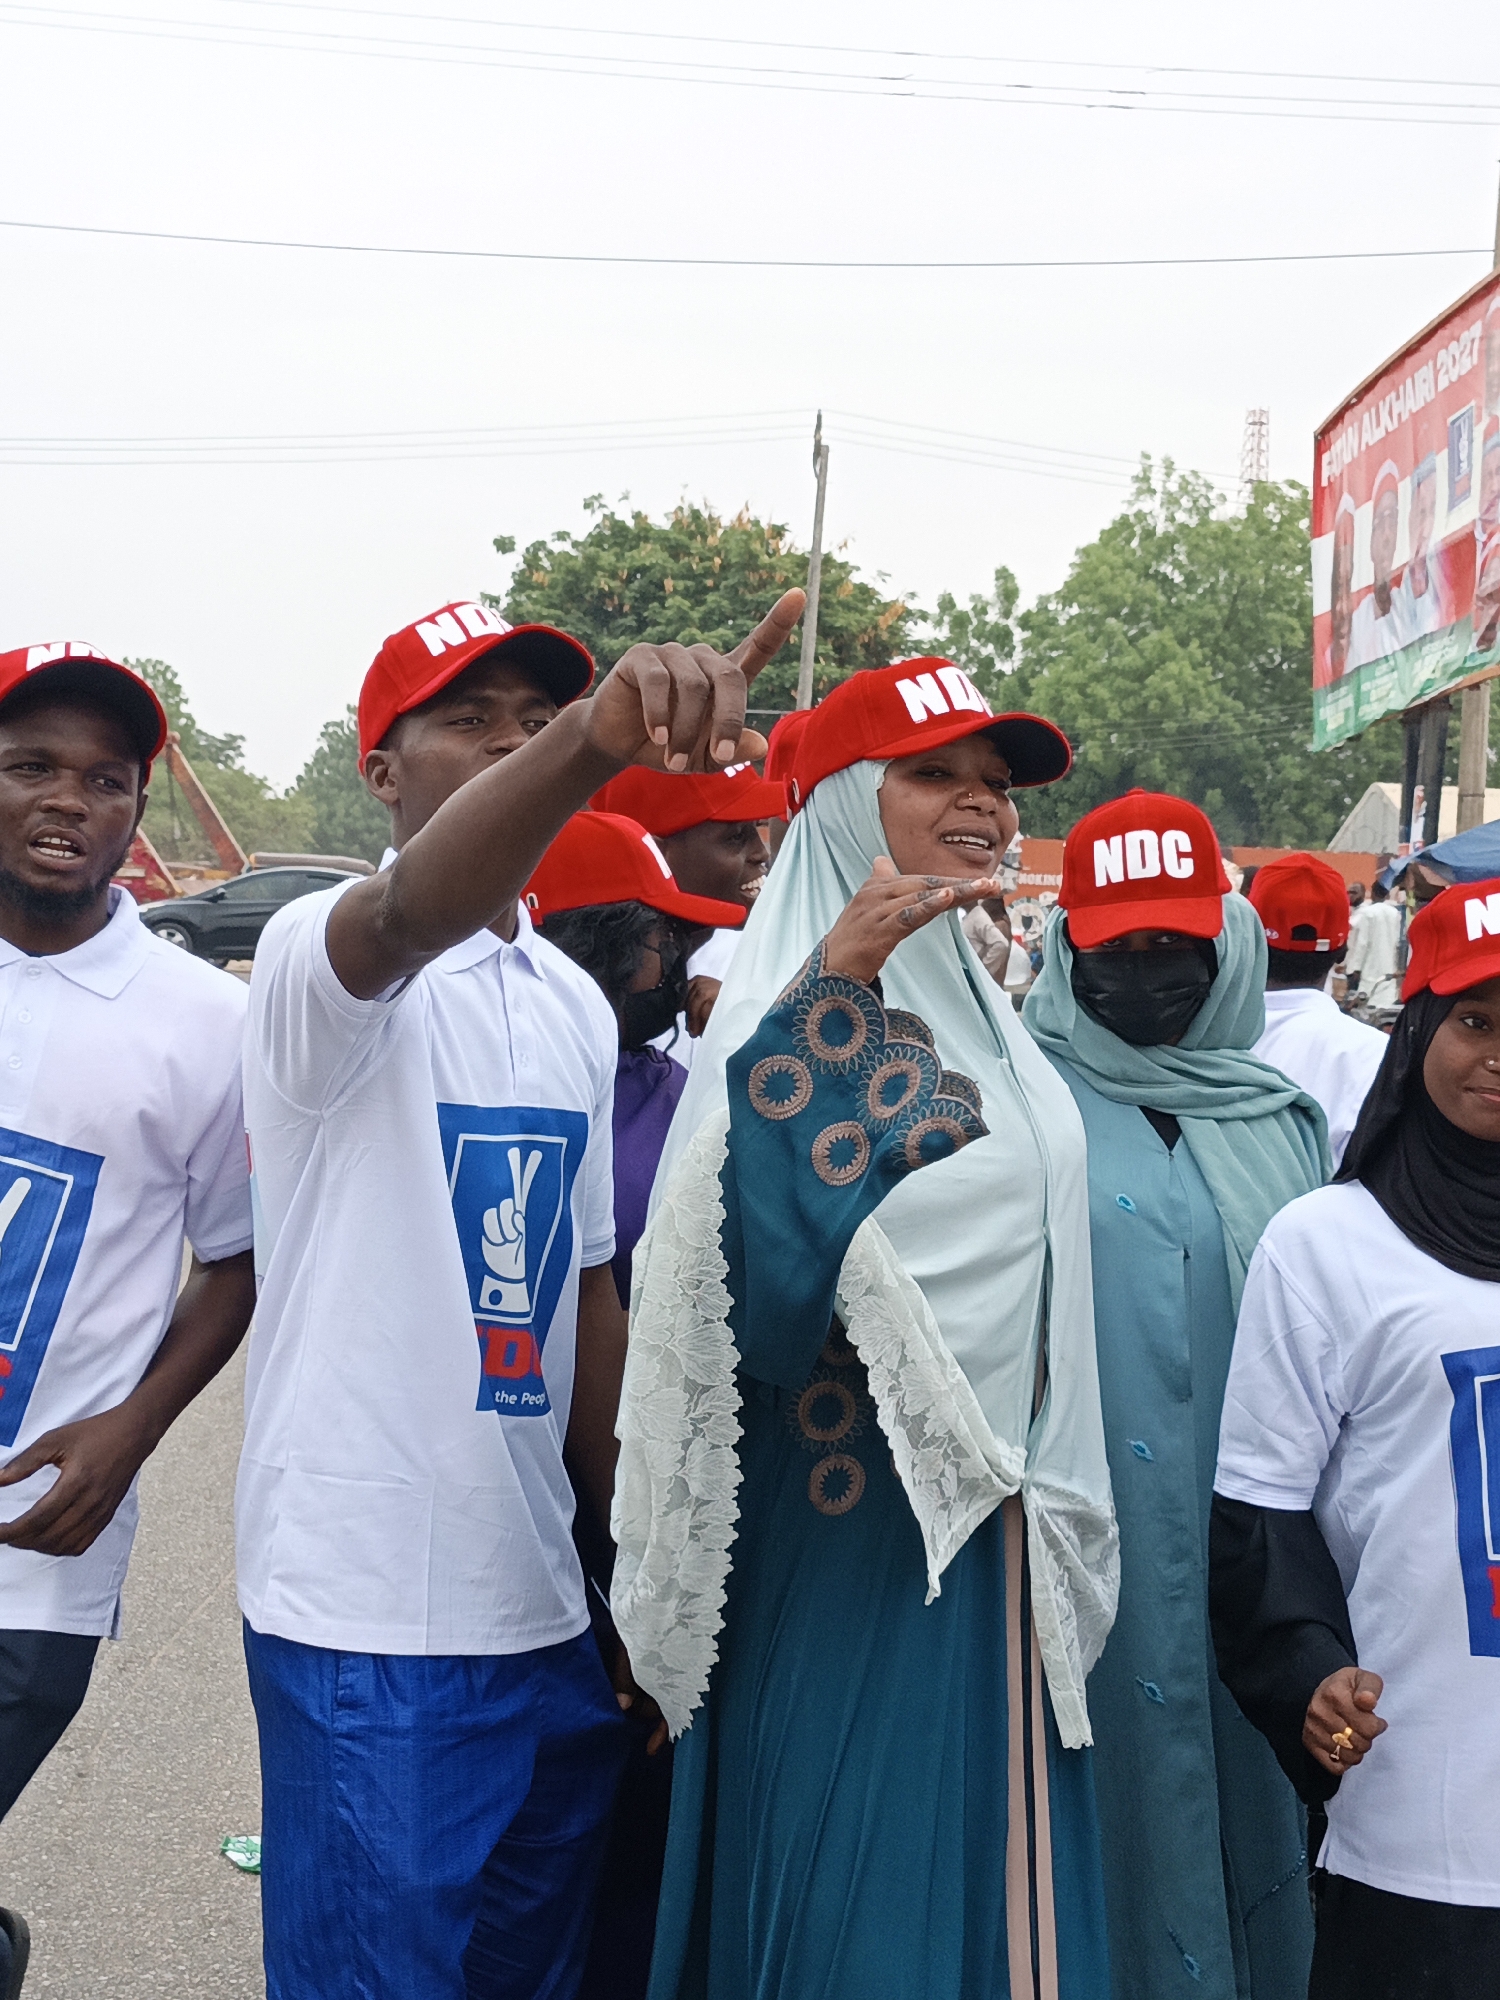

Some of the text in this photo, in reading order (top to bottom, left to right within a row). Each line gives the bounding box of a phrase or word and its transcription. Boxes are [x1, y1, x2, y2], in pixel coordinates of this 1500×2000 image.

[1437, 320, 1482, 392] 2027
[415, 603, 514, 656] ND
[895, 666, 994, 724] ND
[1094, 829, 1194, 887] NDC
[495, 1390, 518, 1405] the
